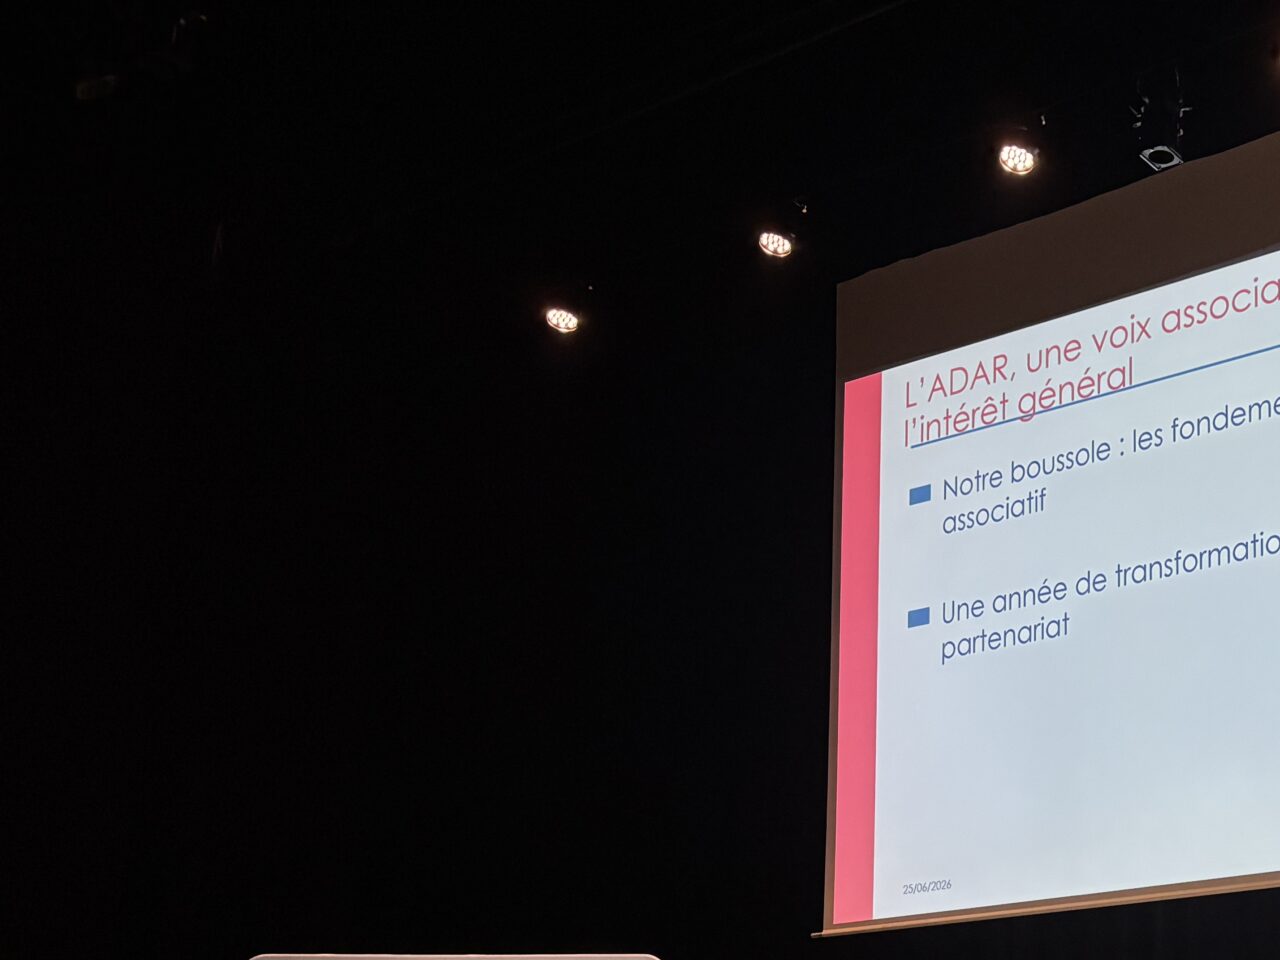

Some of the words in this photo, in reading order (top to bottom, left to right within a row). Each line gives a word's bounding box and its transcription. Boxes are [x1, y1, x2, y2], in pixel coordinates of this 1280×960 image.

[905, 354, 1016, 408] L'ADAR,
[1026, 339, 1082, 373] une
[1092, 314, 1152, 352] voix
[904, 392, 1009, 447] l'intérêt
[1018, 356, 1134, 422] général
[943, 469, 1003, 500] Notre
[1011, 440, 1112, 484] boussole
[1119, 437, 1125, 456] :
[1133, 427, 1164, 453] les
[942, 487, 1047, 534] associatif
[942, 600, 985, 624] Une
[992, 578, 1068, 615] année
[1075, 570, 1107, 596] de
[941, 612, 1071, 665] partenariat
[902, 879, 952, 895] 25/06/2026
